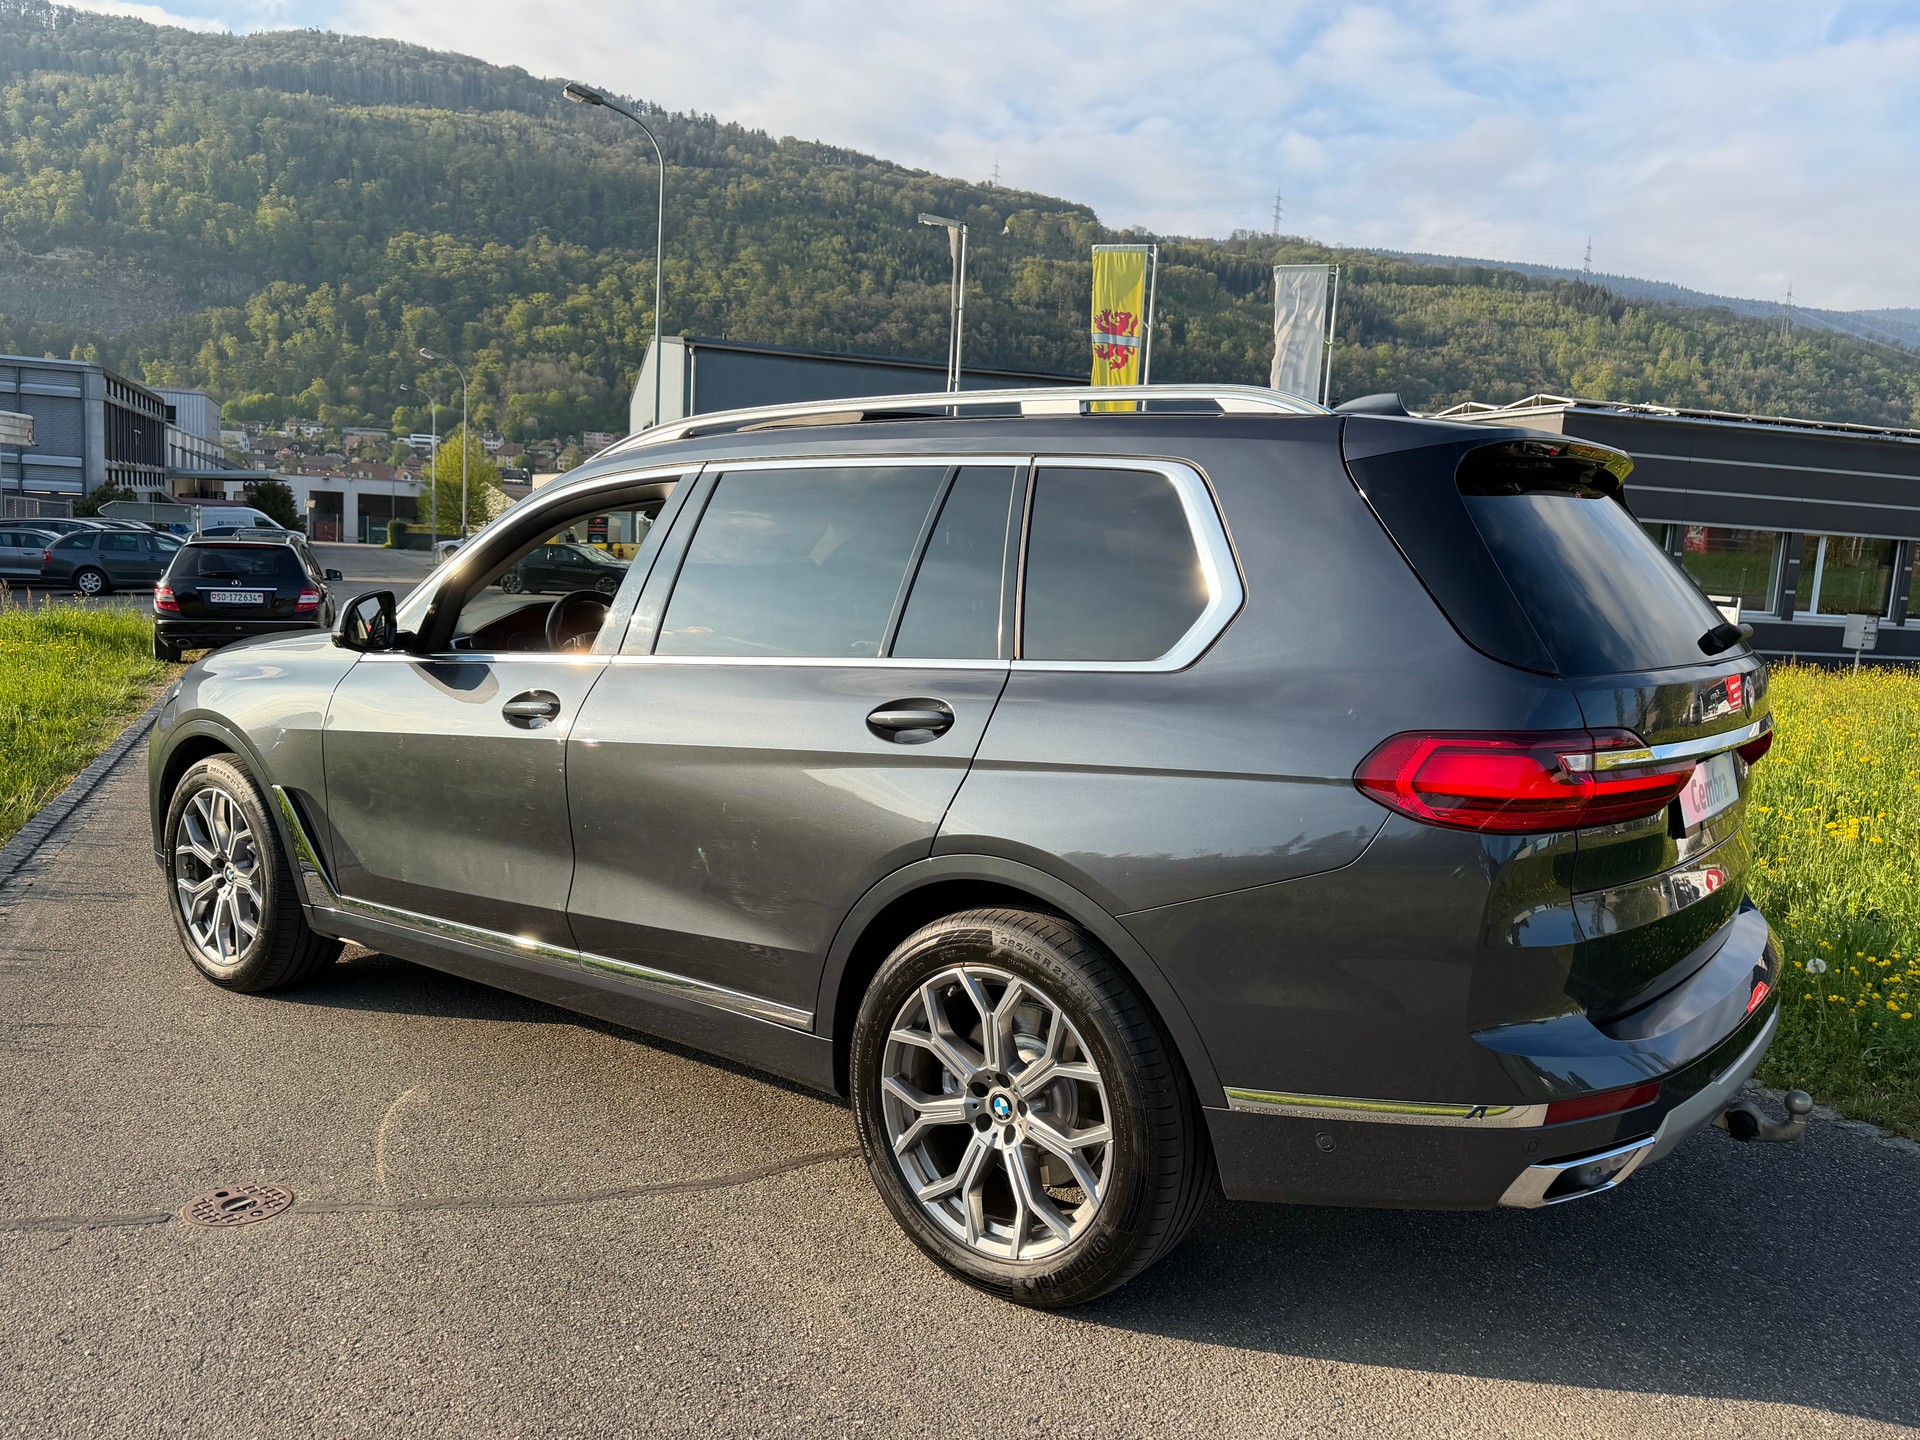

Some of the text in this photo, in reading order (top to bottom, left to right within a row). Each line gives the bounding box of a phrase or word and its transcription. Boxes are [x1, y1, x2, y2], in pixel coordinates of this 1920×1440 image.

[1691, 768, 1730, 814] Cembra
[999, 937, 1041, 961] 285/45
[1042, 958, 1052, 968] R
